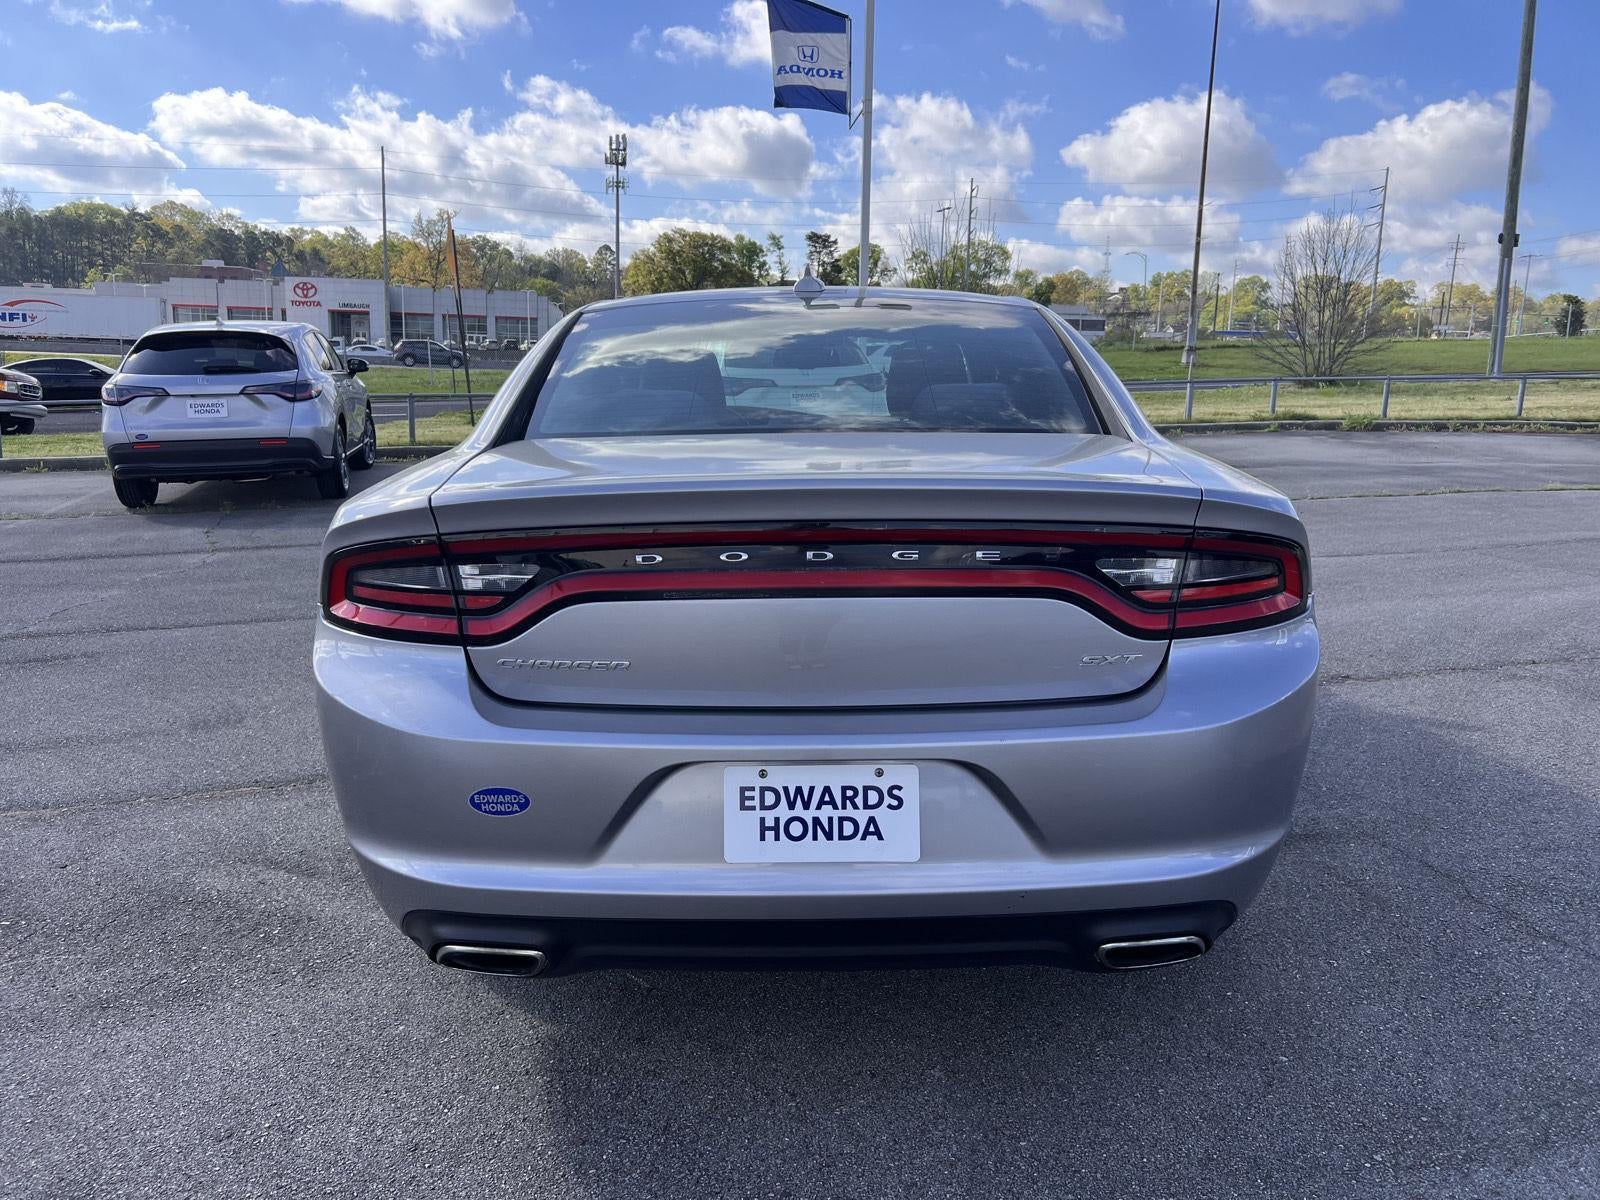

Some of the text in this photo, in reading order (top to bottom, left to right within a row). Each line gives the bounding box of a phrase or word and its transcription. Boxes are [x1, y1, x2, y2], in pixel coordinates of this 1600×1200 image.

[635, 550, 1001, 565] DODGE
[497, 658, 631, 671] CHARGER
[1080, 653, 1143, 666] SXT
[474, 795, 526, 803] EDWARDS
[739, 784, 904, 811] EDWARDS
[481, 804, 520, 812] HONDA
[759, 815, 884, 842] HONDA
